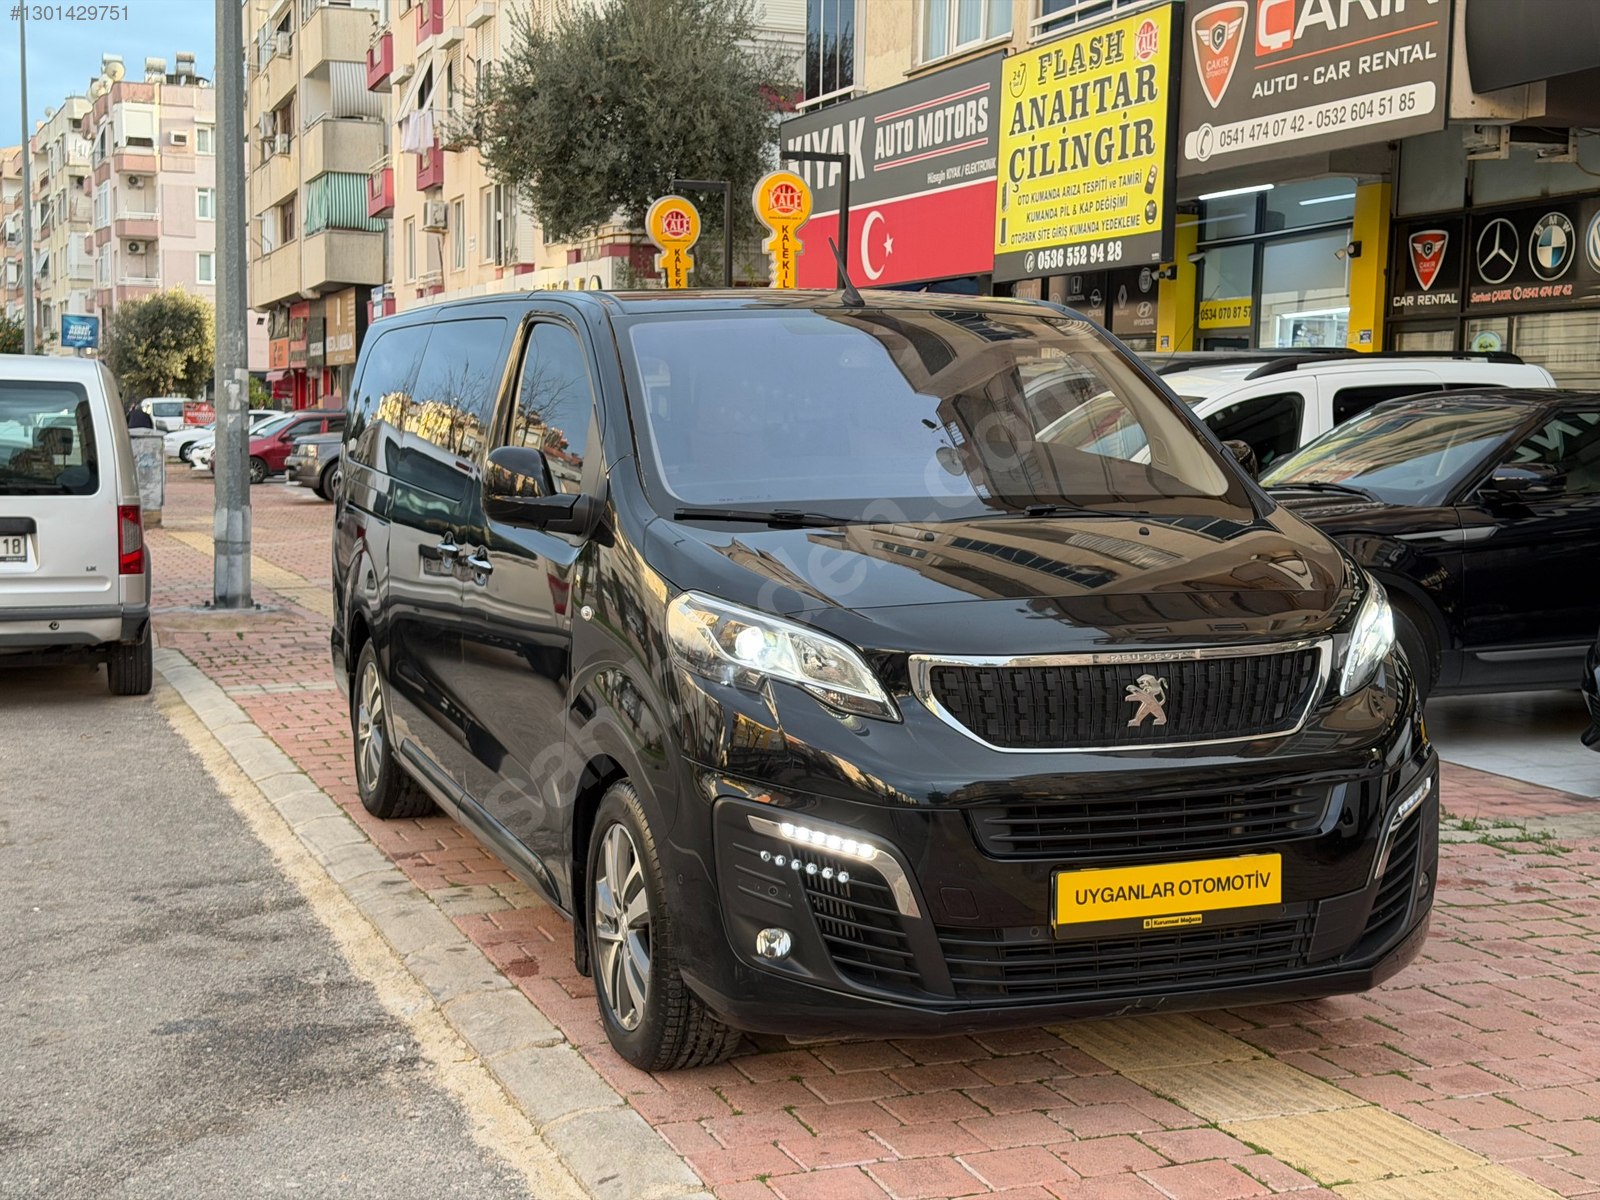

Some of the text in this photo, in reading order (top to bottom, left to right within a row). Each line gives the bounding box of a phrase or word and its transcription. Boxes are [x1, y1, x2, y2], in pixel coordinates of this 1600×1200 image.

[1038, 30, 1125, 85] FLASH
[1252, 74, 1298, 99] AUTO
[1313, 64, 1350, 85] CAR
[1358, 41, 1437, 75] RENTAL
[1009, 64, 1158, 136] ANAHTAR
[875, 118, 913, 160] AUTO
[917, 97, 989, 149] MOTORS
[1219, 127, 1245, 148] 0541
[1249, 123, 1269, 142] 474
[1272, 119, 1286, 137] 07
[1290, 115, 1304, 133] 42
[1316, 106, 1346, 129] 0532
[1350, 101, 1374, 122] 604
[1378, 95, 1393, 116] 51
[1399, 91, 1416, 112] 85
[1009, 111, 1156, 193] ÇİLİNGİR
[768, 191, 803, 210] KALE
[1018, 169, 1143, 206] OTO KUMANDA ARIZA TESPİTİ ve TAMİRİ
[1026, 209, 1058, 223] KUMANDA
[1060, 205, 1070, 220] PİL
[1079, 201, 1093, 214] KAP
[1095, 193, 1128, 212] DEĞİŞİMİ
[661, 216, 691, 234] KALE
[1011, 214, 1141, 245] OTOPARK SİTE GİRİŞ KUMANDA YEDEKLEME
[1037, 241, 1122, 270] 0536 552 94 28
[1200, 305, 1252, 320] 0534 070 87 57
[1393, 293, 1458, 307] CAR RENTAL
[3, 538, 21, 555] 18
[1110, 652, 1182, 663] PEUGEOT
[1075, 870, 1272, 906] UYGANLAR OTOMOTİV
